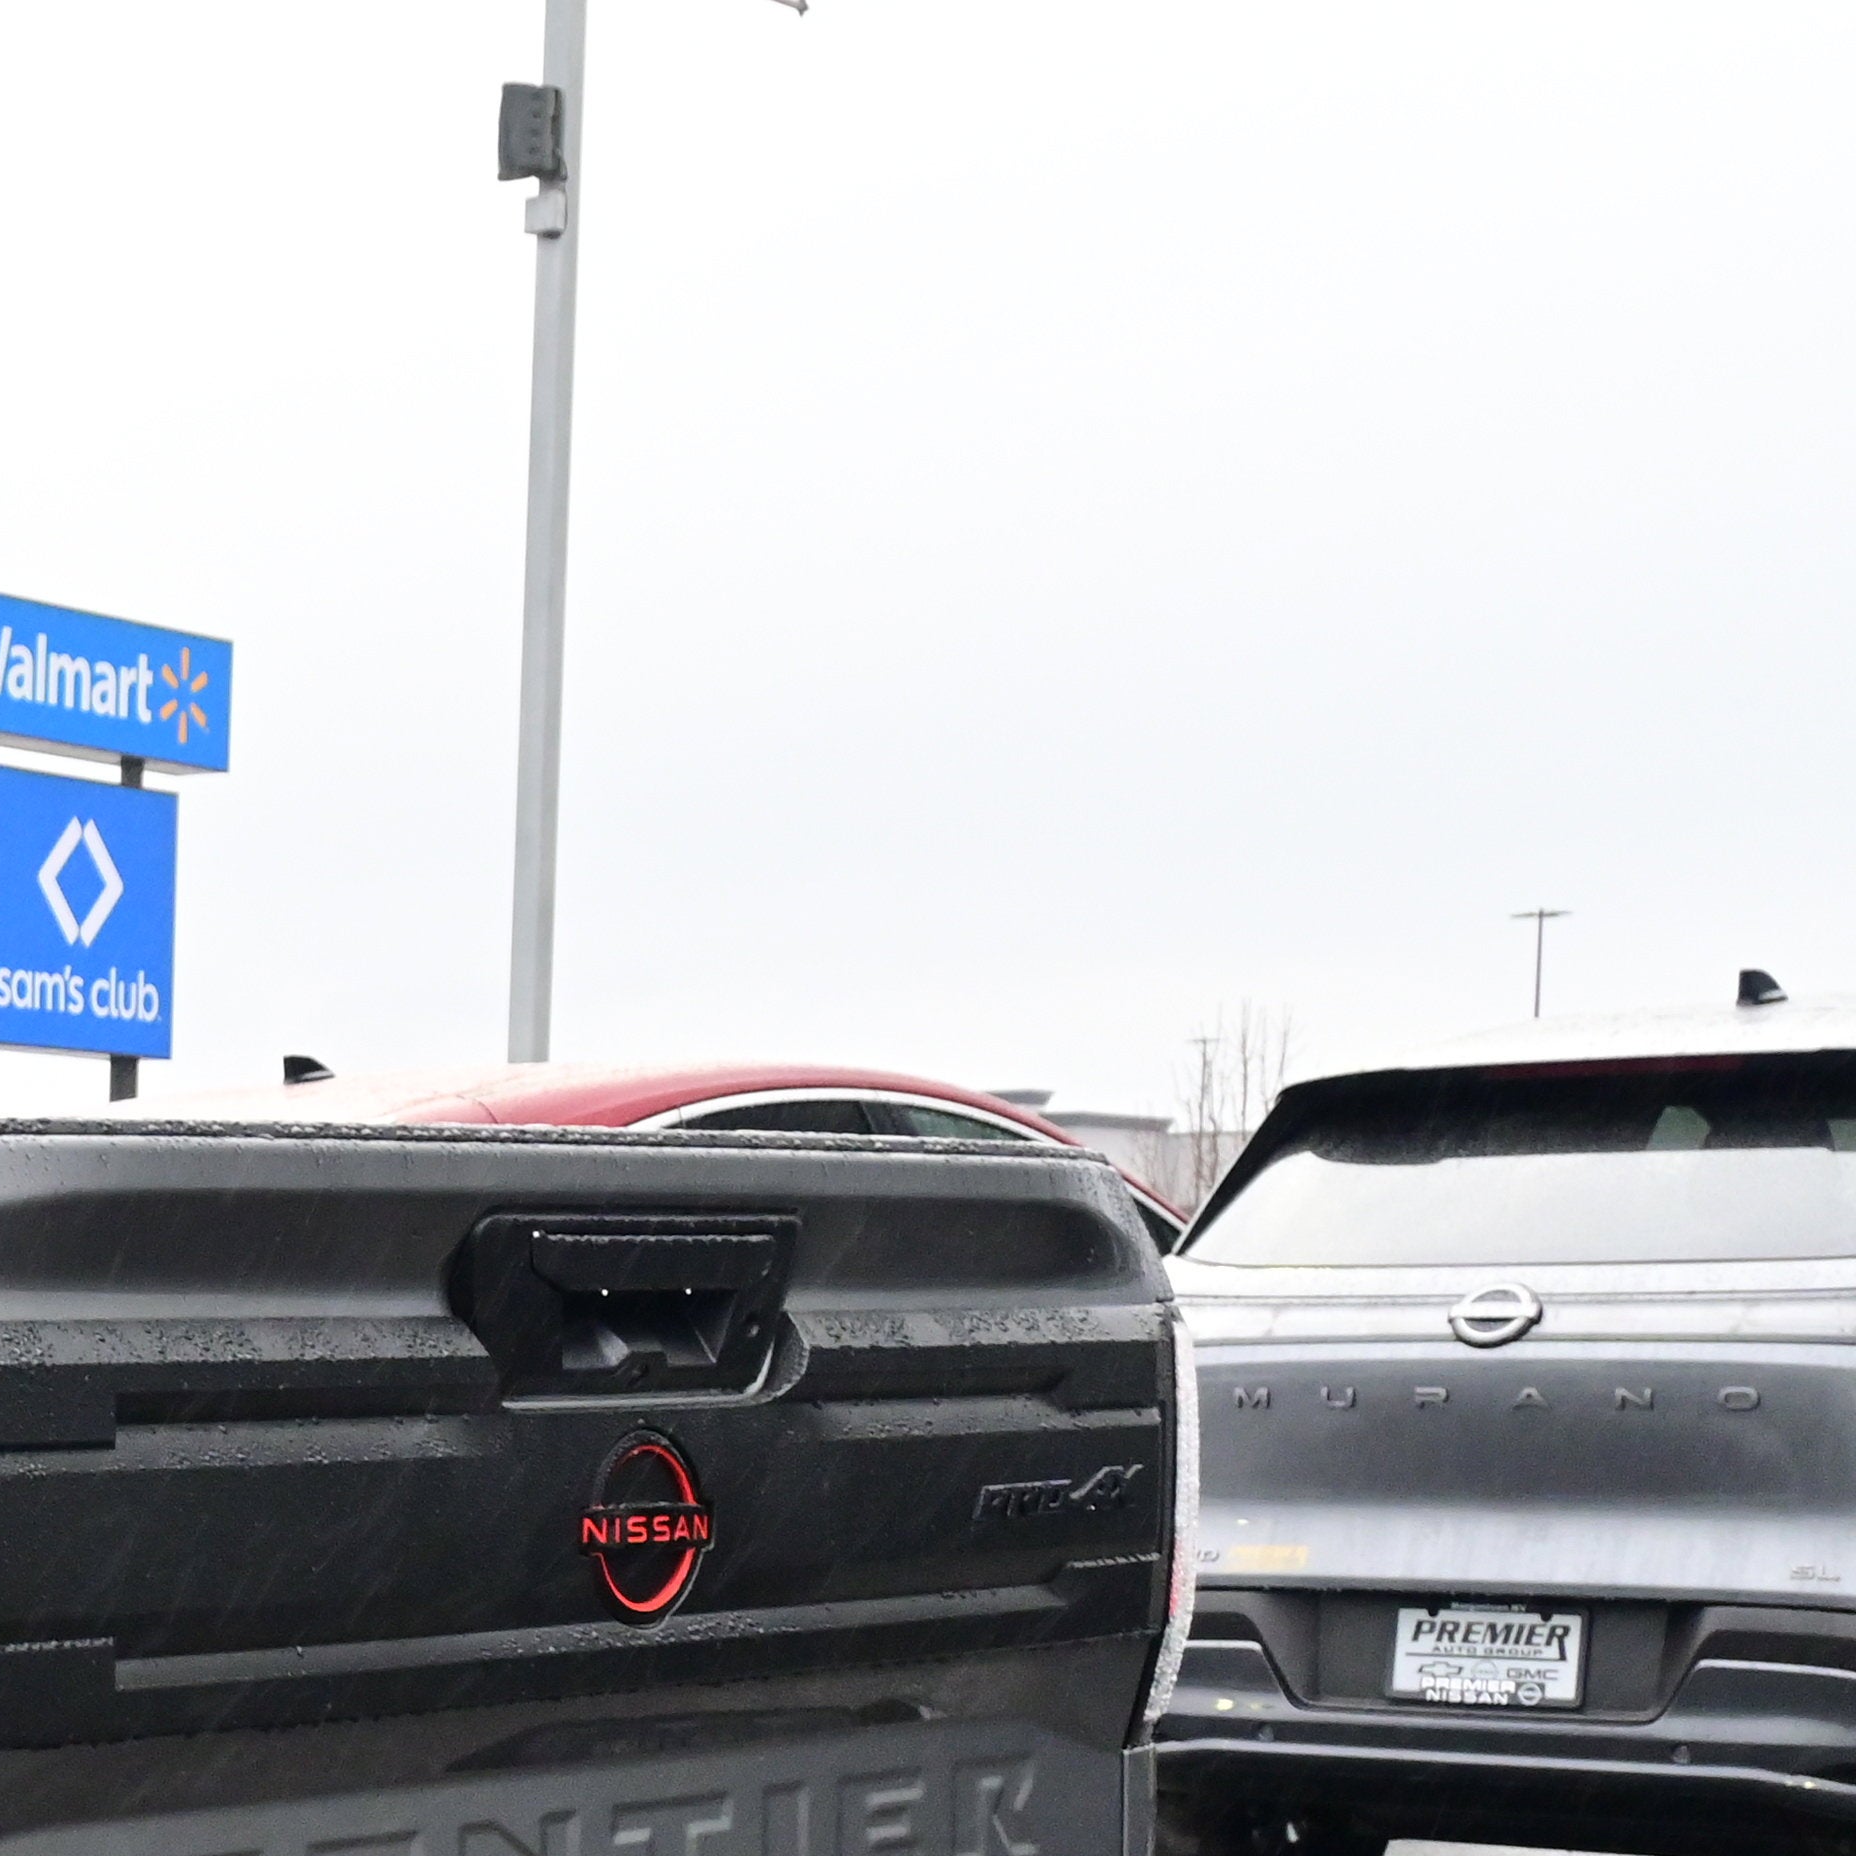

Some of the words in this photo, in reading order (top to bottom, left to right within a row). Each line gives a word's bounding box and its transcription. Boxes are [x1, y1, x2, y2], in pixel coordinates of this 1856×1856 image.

[90, 967, 161, 1023] club
[1233, 1385, 1762, 1412] MURANO
[582, 1513, 710, 1544] NISSAN
[1411, 1619, 1572, 1660] PREMIER
[1431, 1645, 1478, 1656] AUTO
[1480, 1646, 1544, 1657] GROUP
[1420, 1676, 1516, 1694] PREMIER
[1506, 1667, 1560, 1681] GMC
[1425, 1688, 1509, 1706] NISSAN
